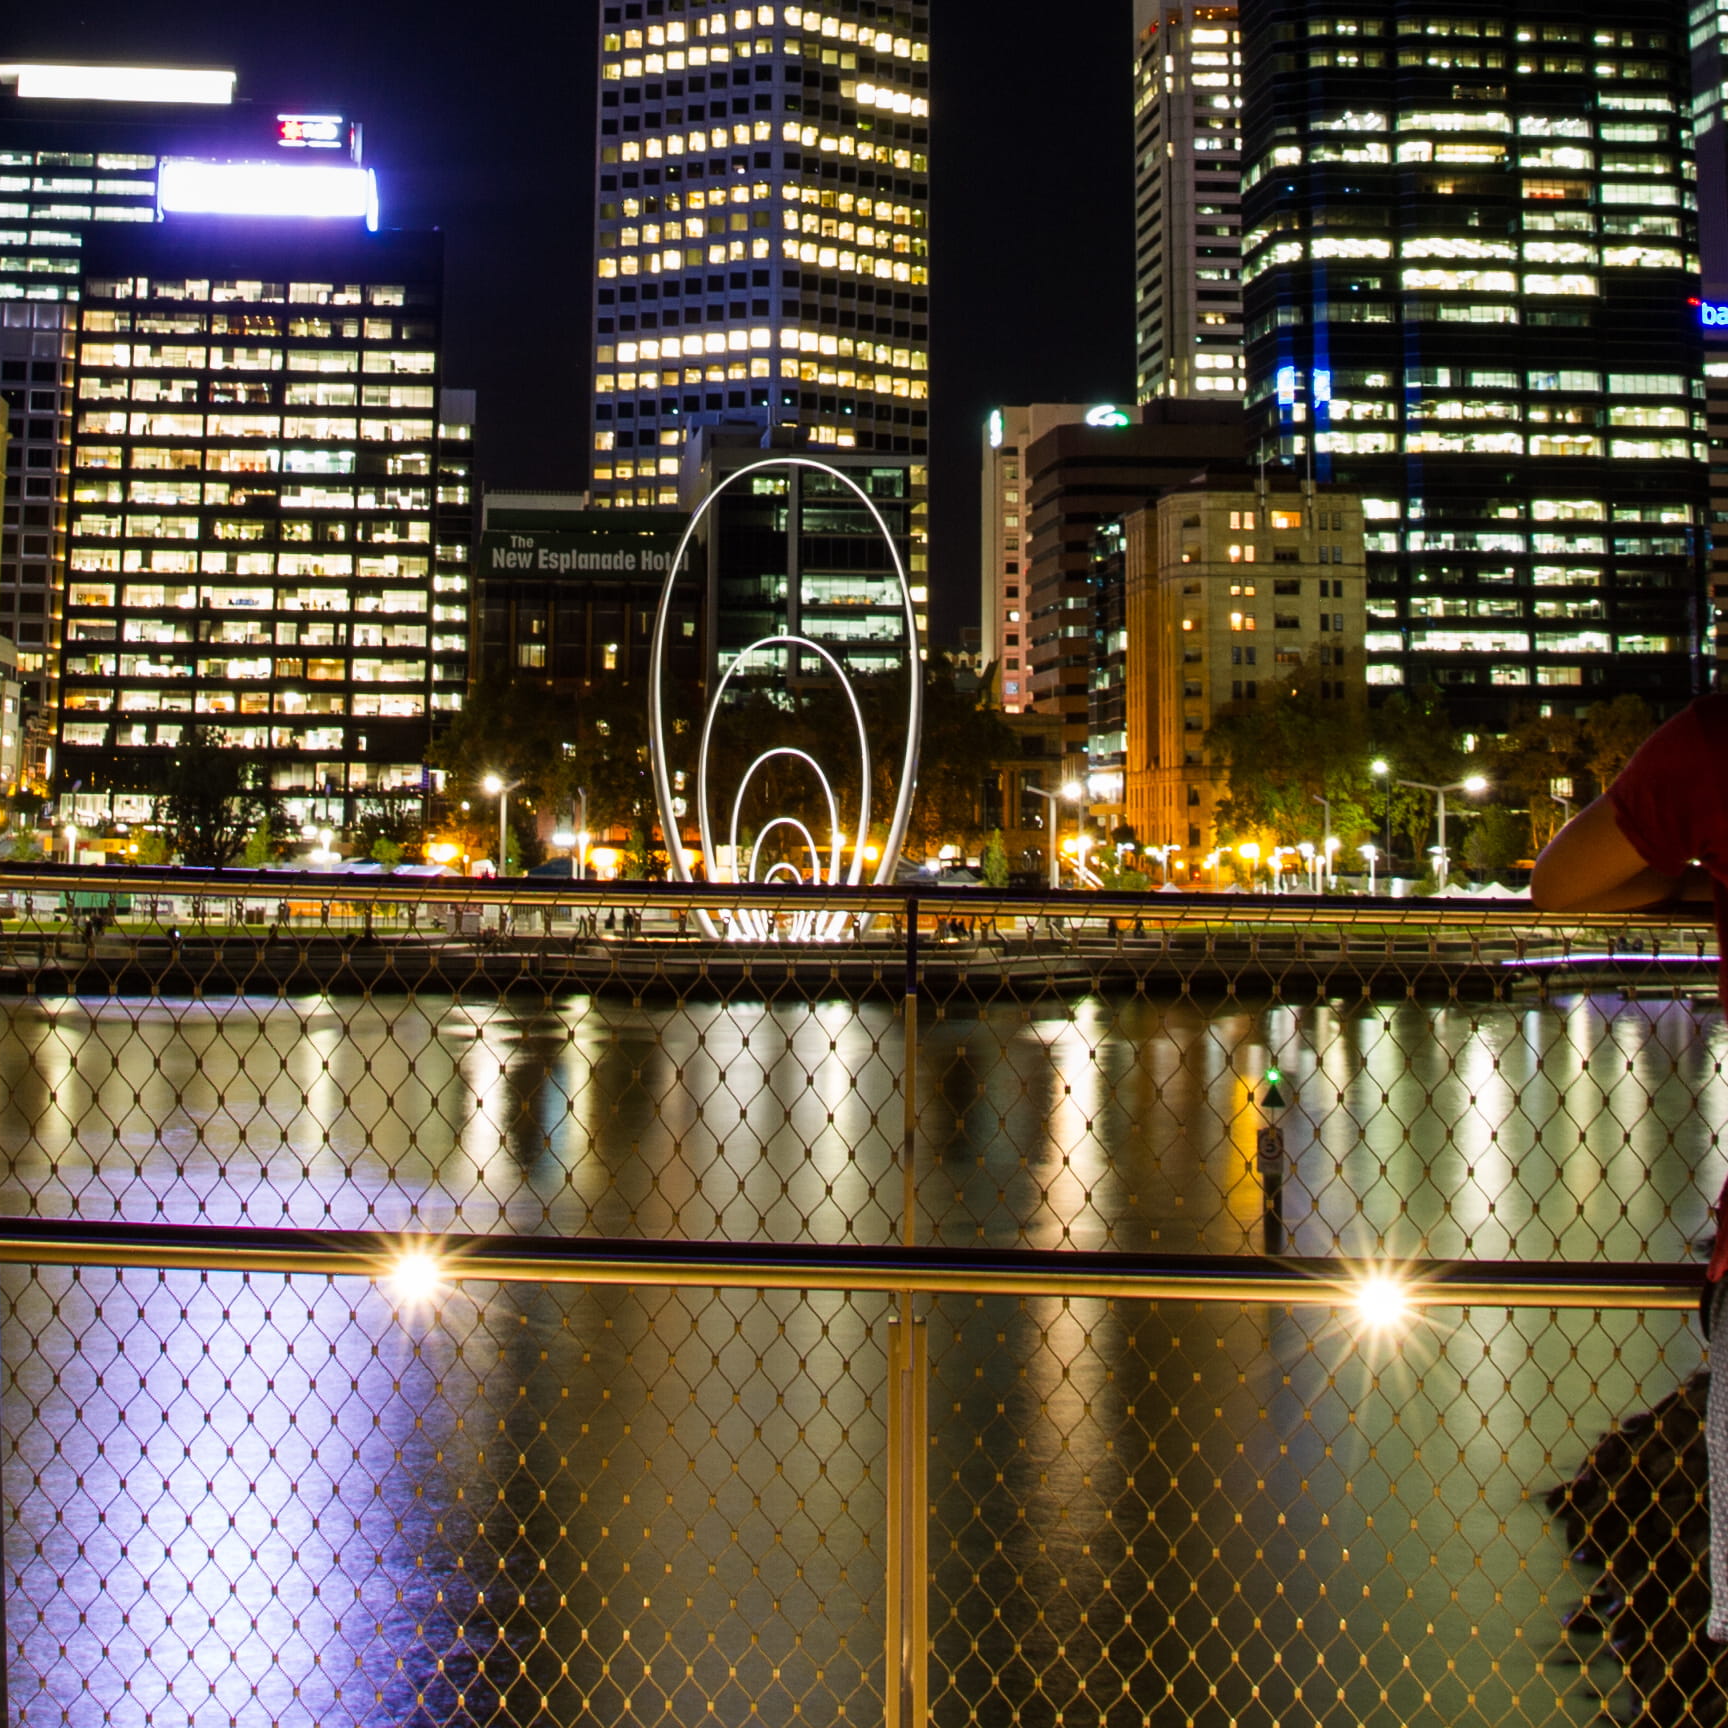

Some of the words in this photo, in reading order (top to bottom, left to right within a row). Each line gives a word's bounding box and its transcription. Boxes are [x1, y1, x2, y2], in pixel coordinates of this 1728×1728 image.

[510, 535, 534, 549] The
[492, 547, 533, 569] New
[538, 548, 636, 574] Esplanade
